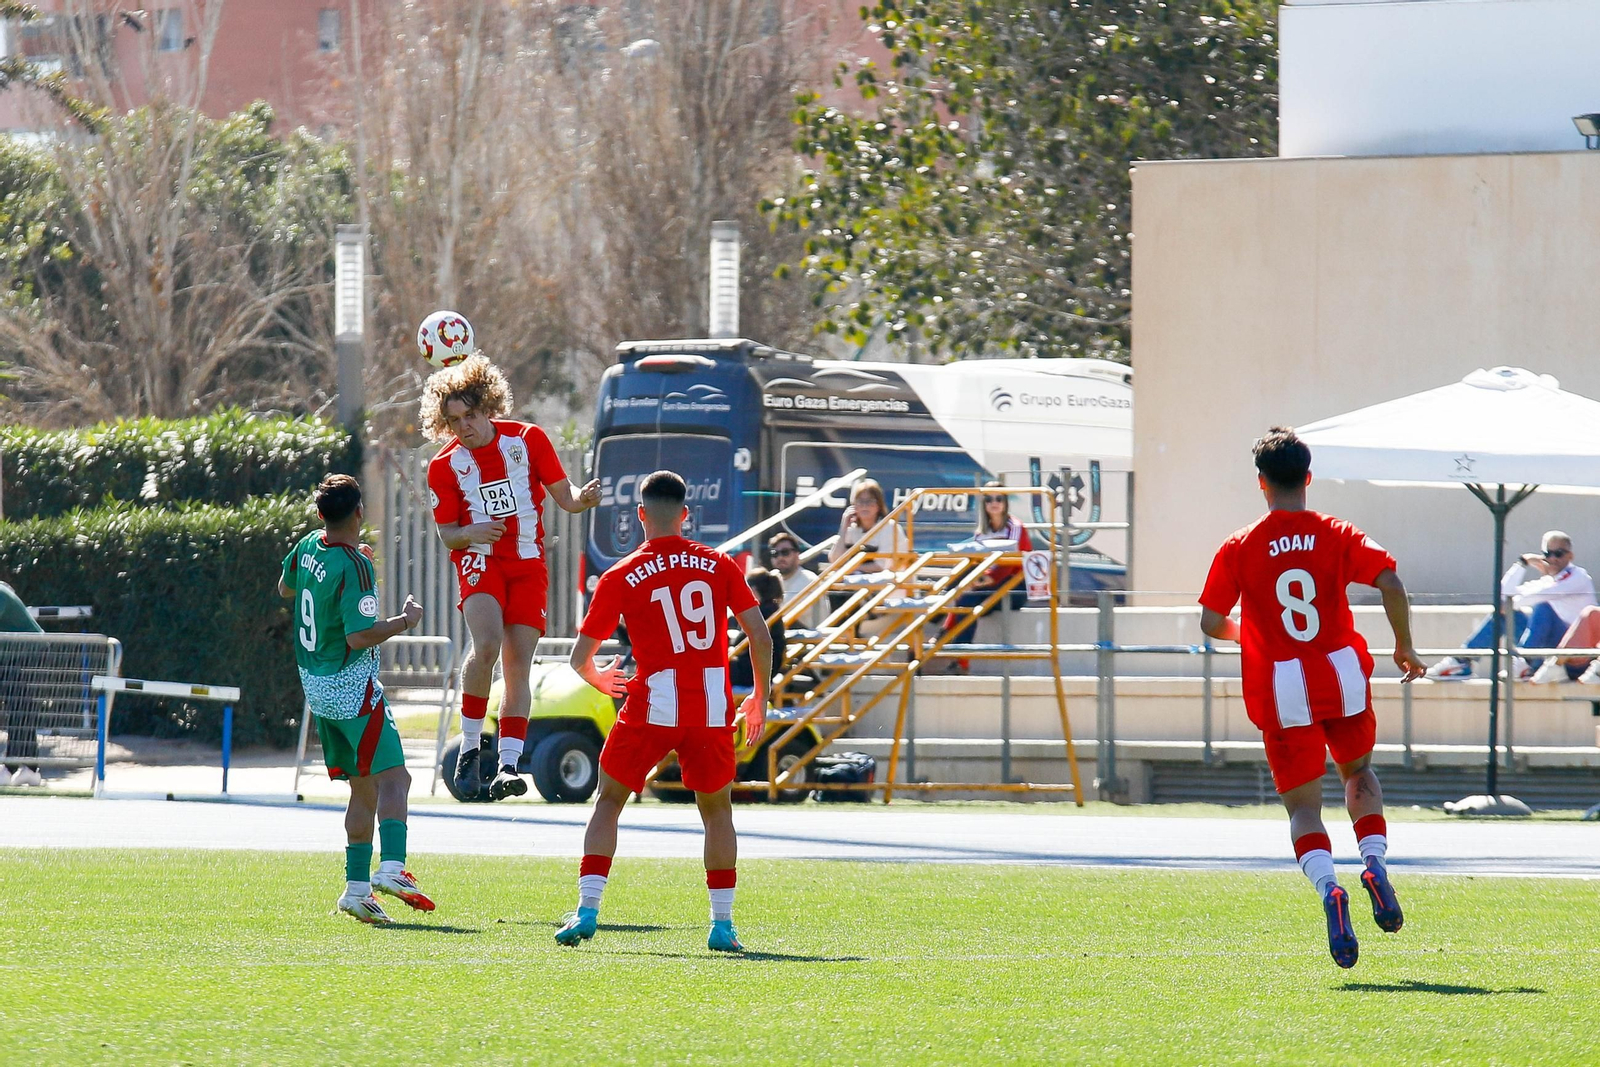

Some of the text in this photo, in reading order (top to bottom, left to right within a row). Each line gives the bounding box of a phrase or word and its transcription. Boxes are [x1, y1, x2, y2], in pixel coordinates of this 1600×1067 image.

[763, 394, 910, 413] Euro Gaza Emergencias
[1020, 393, 1131, 409] Grupo EuroGaza
[488, 487, 507, 500] DA
[685, 478, 722, 500] brid
[492, 499, 510, 512] ZN
[1268, 534, 1316, 557] JOAN
[461, 553, 487, 576] 24
[625, 551, 717, 588] RENÉ PÉREZ
[1275, 568, 1320, 642] 8
[299, 588, 317, 652] 9
[650, 580, 716, 654] 19
